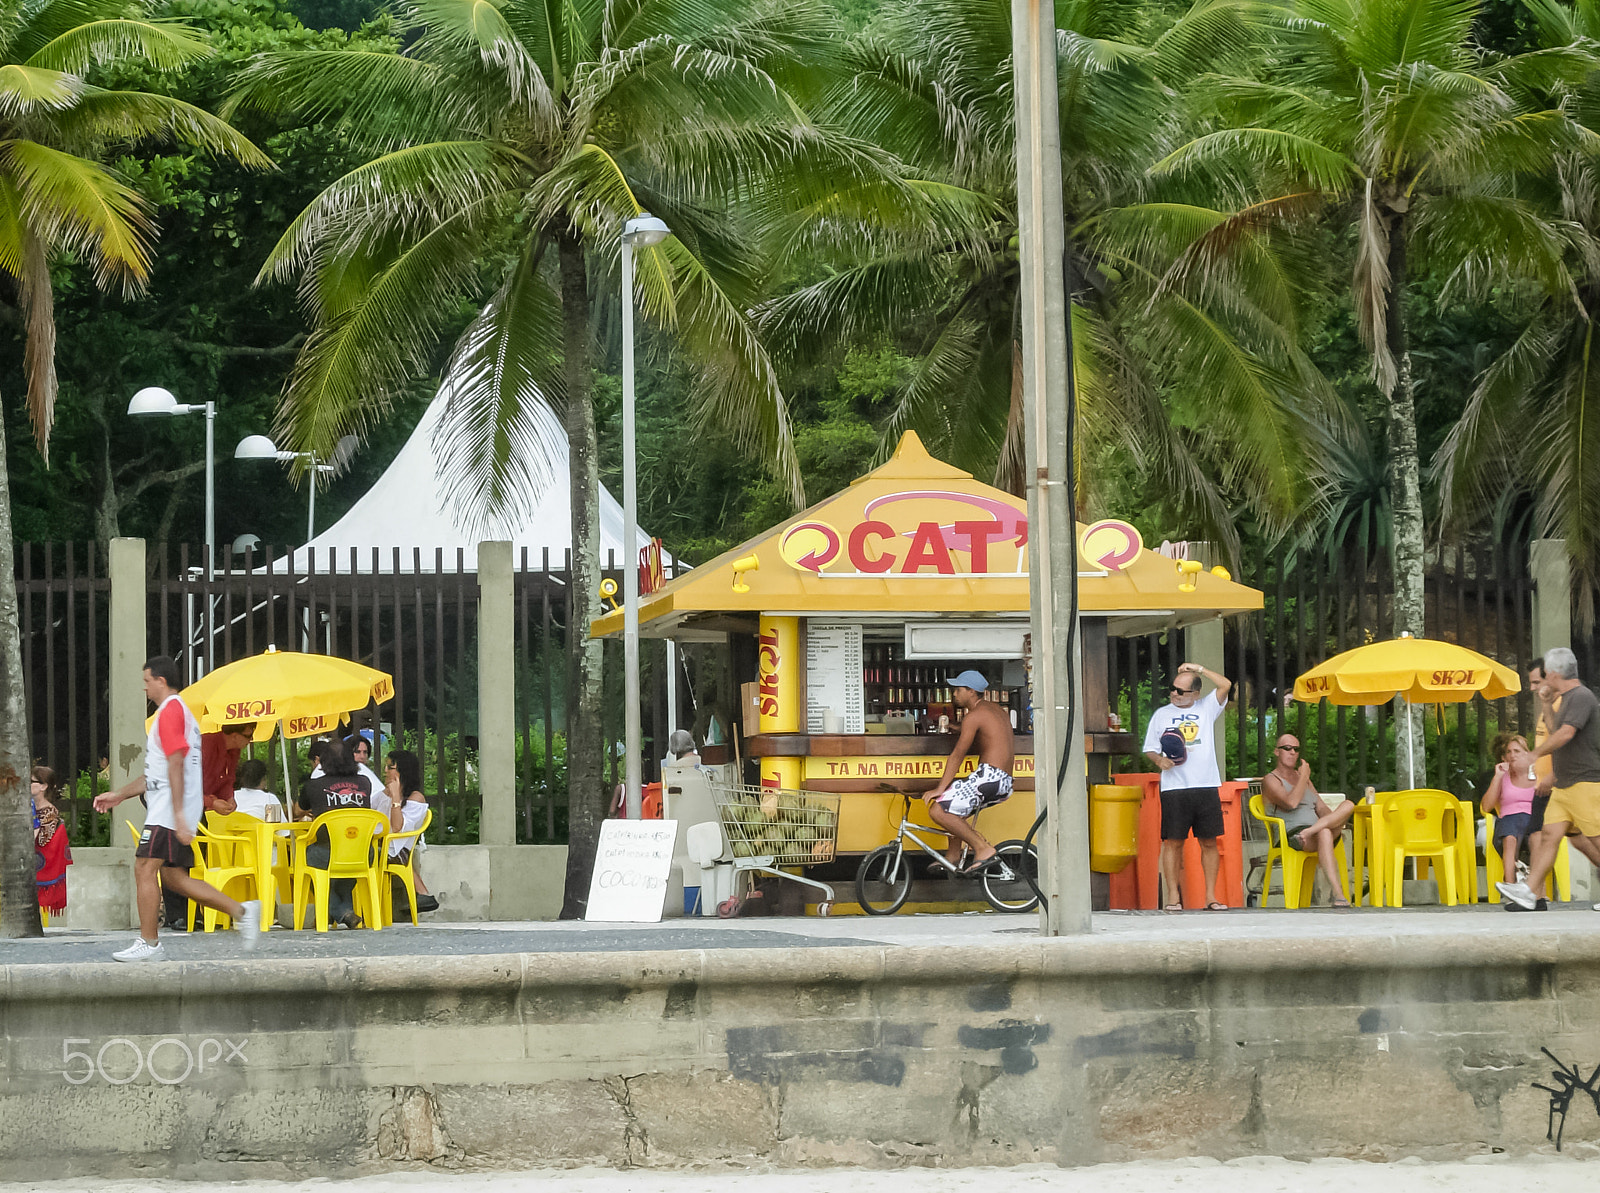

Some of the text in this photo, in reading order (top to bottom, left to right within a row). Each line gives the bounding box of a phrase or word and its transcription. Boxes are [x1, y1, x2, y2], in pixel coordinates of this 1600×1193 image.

[847, 520, 1028, 575] CAT'
[759, 627, 781, 718] SKOL
[1431, 669, 1476, 686] SKOL
[1306, 675, 1330, 694] SKOL
[225, 699, 276, 720] SKOL
[1172, 713, 1200, 725] NO
[289, 714, 328, 735] SKOL
[826, 760, 850, 775] TÁ
[856, 763, 879, 776] NA
[885, 761, 943, 775] PRAIA?
